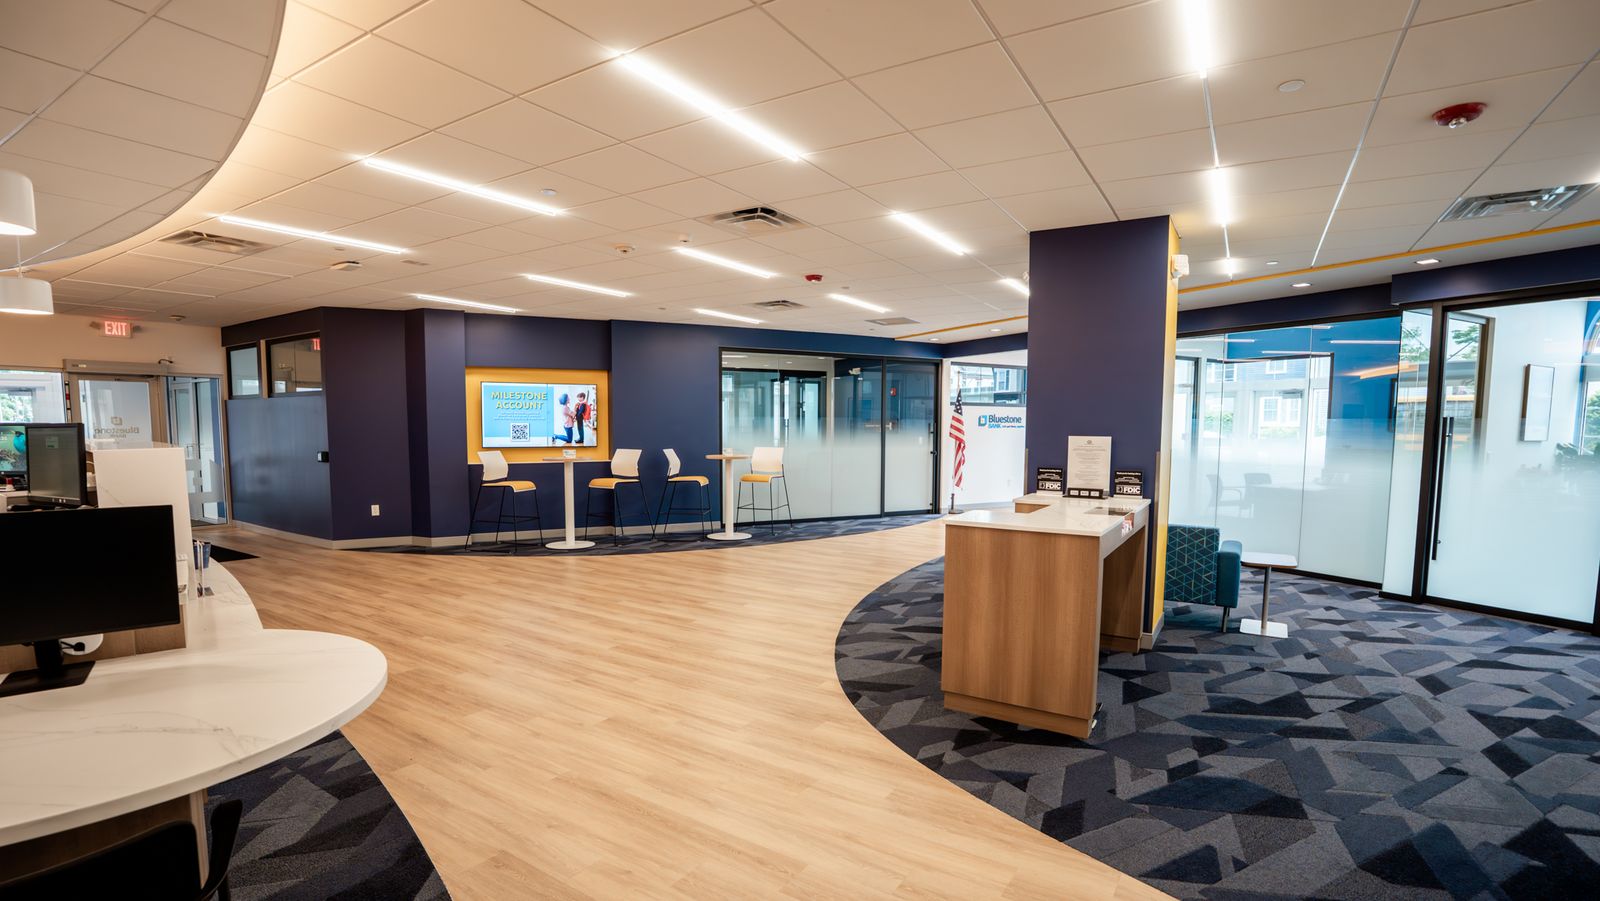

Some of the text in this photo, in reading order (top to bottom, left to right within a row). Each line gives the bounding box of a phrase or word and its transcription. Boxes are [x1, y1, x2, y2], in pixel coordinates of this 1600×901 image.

[104, 321, 127, 336] EXIT
[491, 391, 548, 400] MILESTONE
[496, 401, 544, 410] ACCOUNT
[988, 414, 1022, 423] Bluestone
[1046, 482, 1061, 490] FDIC
[1124, 485, 1140, 494] FDIC
